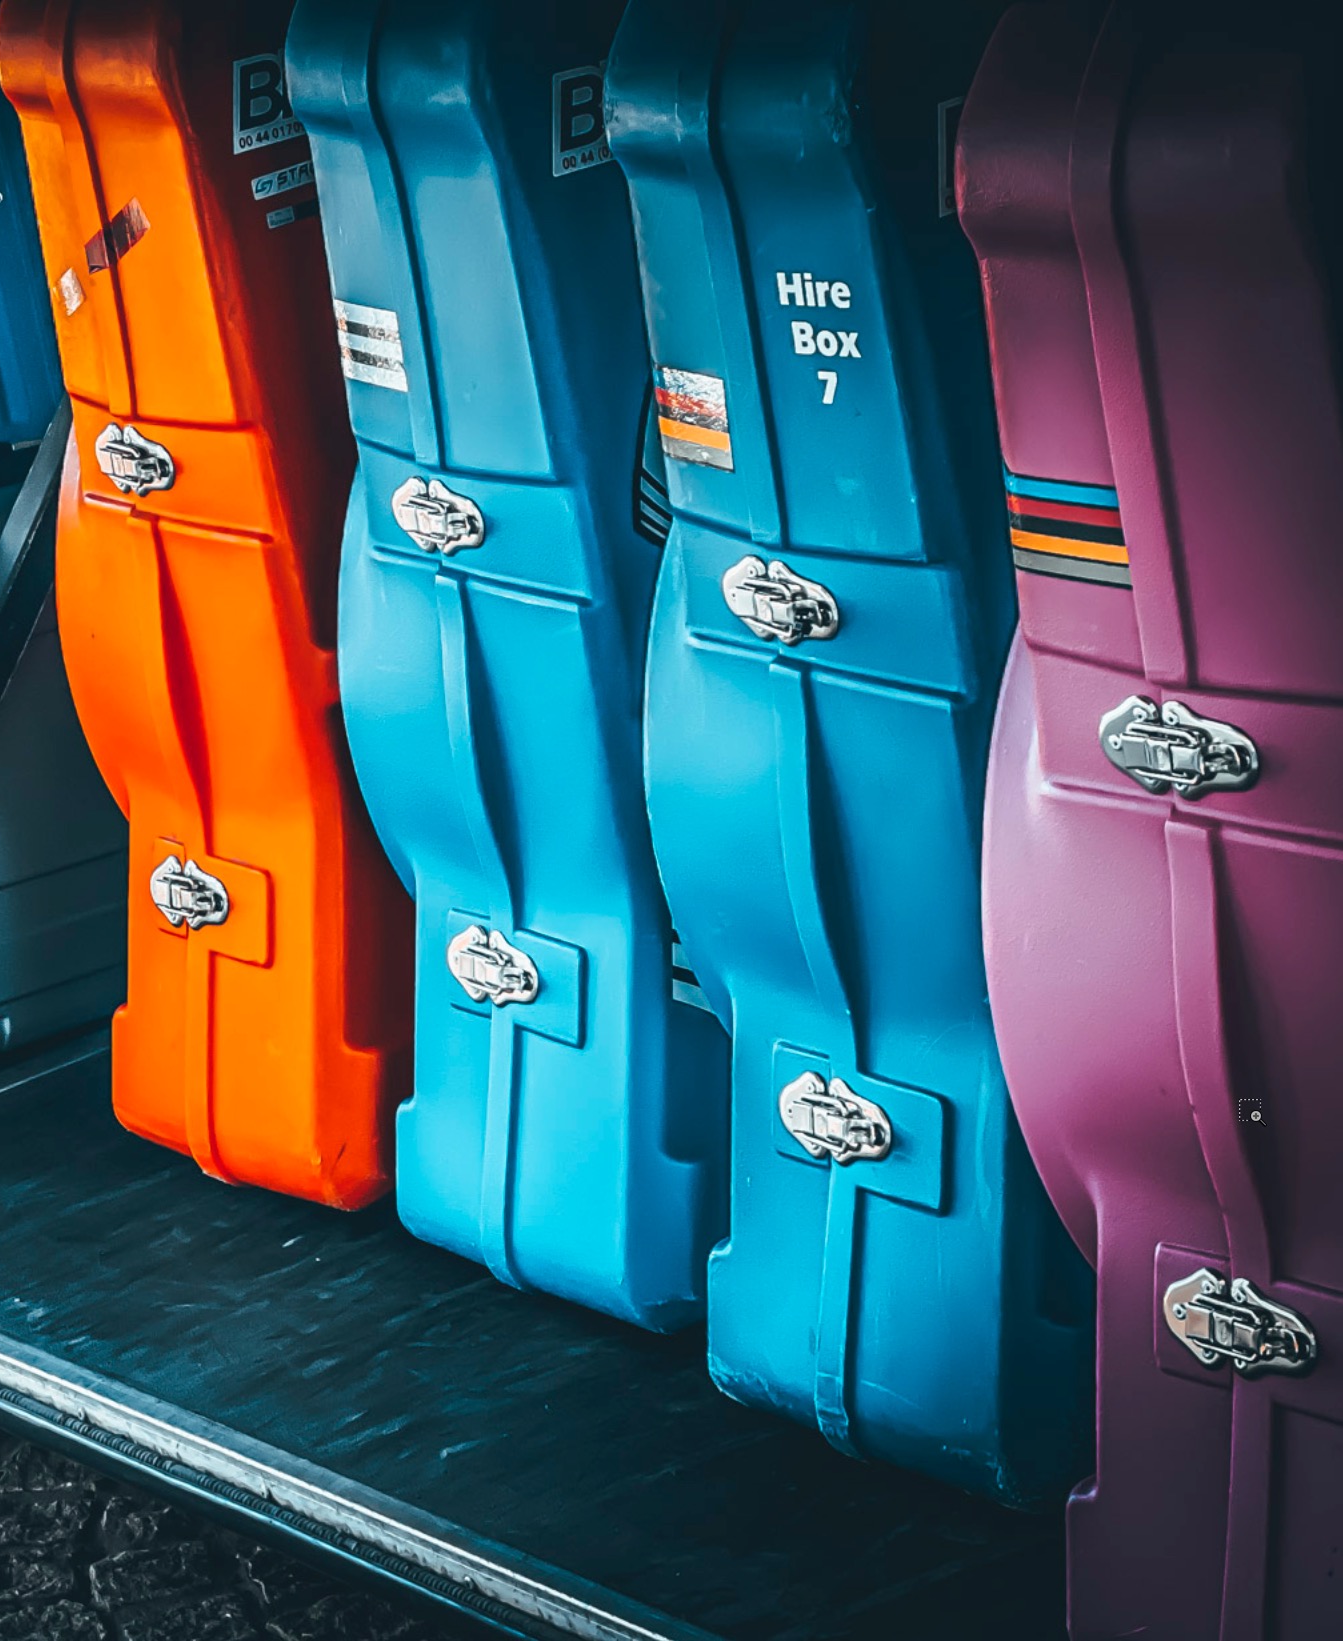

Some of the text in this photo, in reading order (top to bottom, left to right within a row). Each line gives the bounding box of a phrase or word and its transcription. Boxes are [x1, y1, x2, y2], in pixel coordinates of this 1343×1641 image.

[239, 135, 253, 149] 00
[256, 129, 270, 143] 44
[562, 156, 576, 170] 00
[776, 271, 851, 309] Hire
[791, 320, 862, 359] Box
[817, 370, 838, 405] 7
